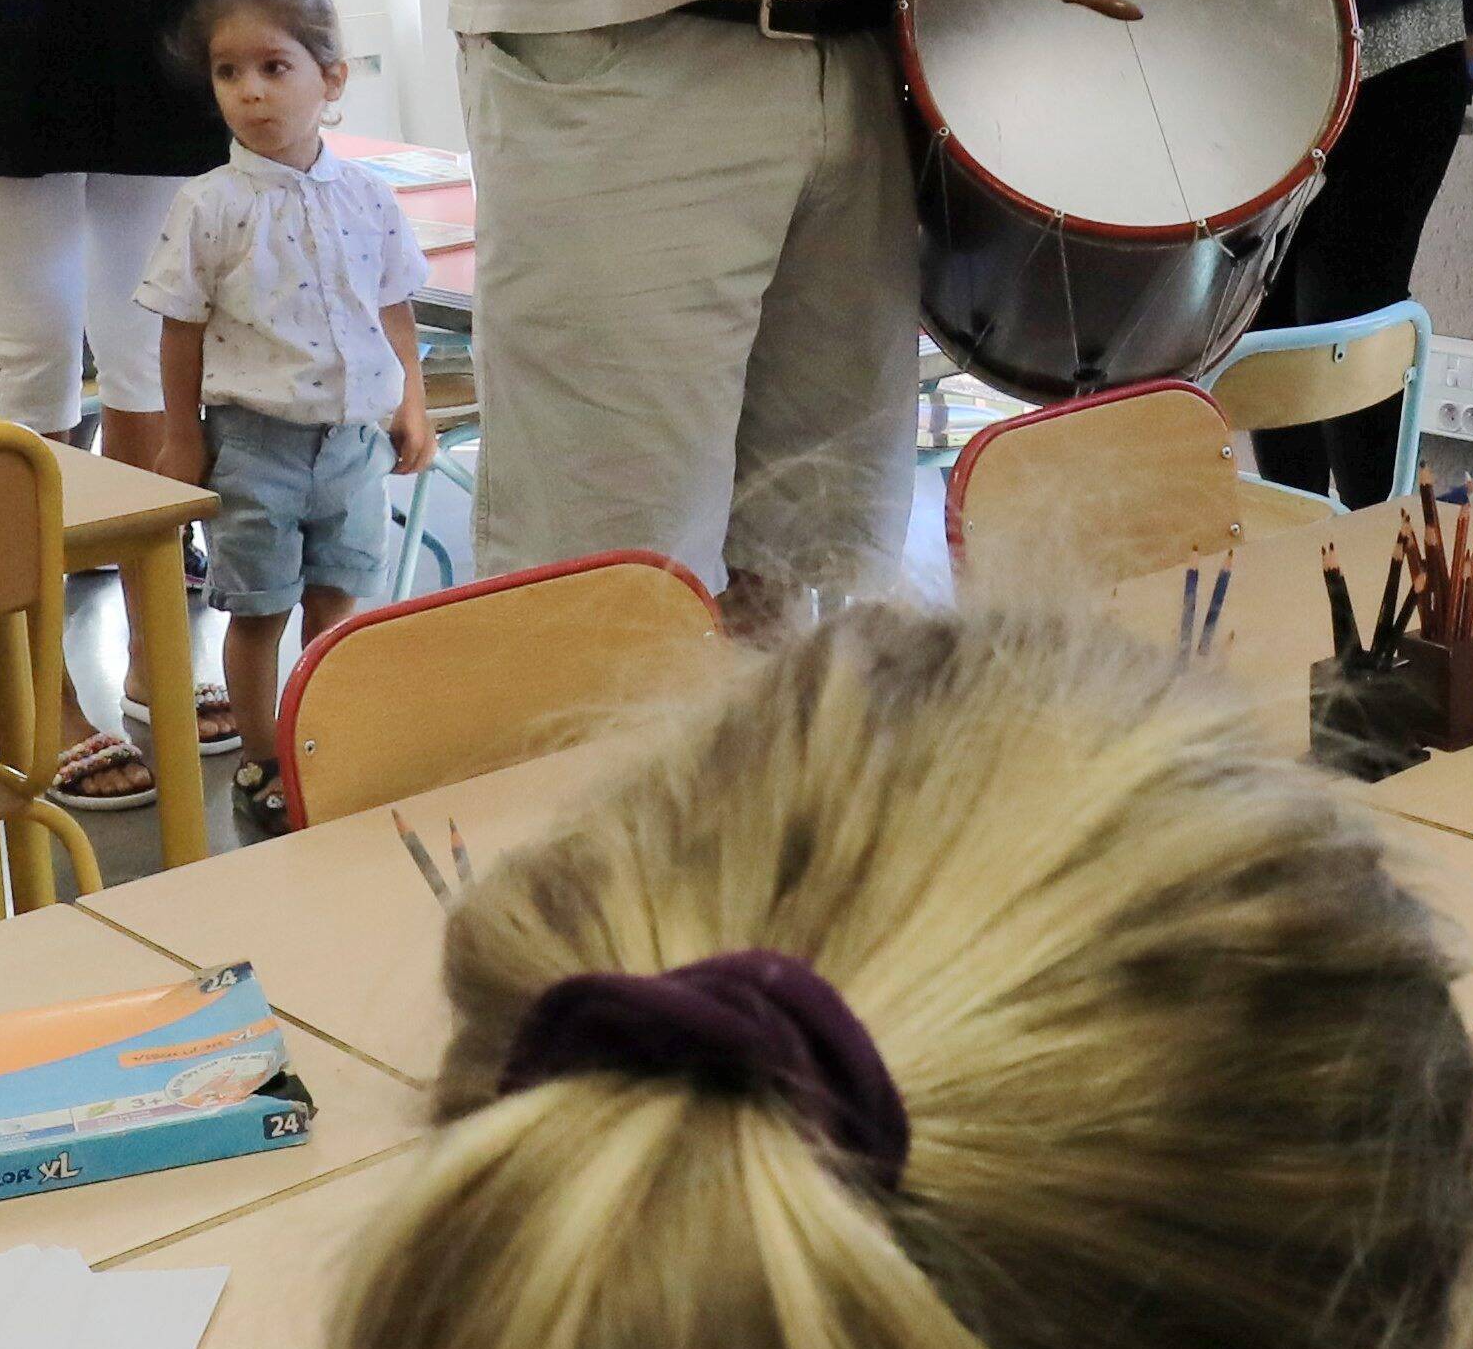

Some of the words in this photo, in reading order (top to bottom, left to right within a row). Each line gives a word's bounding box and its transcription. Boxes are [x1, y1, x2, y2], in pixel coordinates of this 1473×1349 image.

[207, 968, 238, 993] 24
[269, 1112, 299, 1138] 24
[37, 1151, 84, 1185] XL
